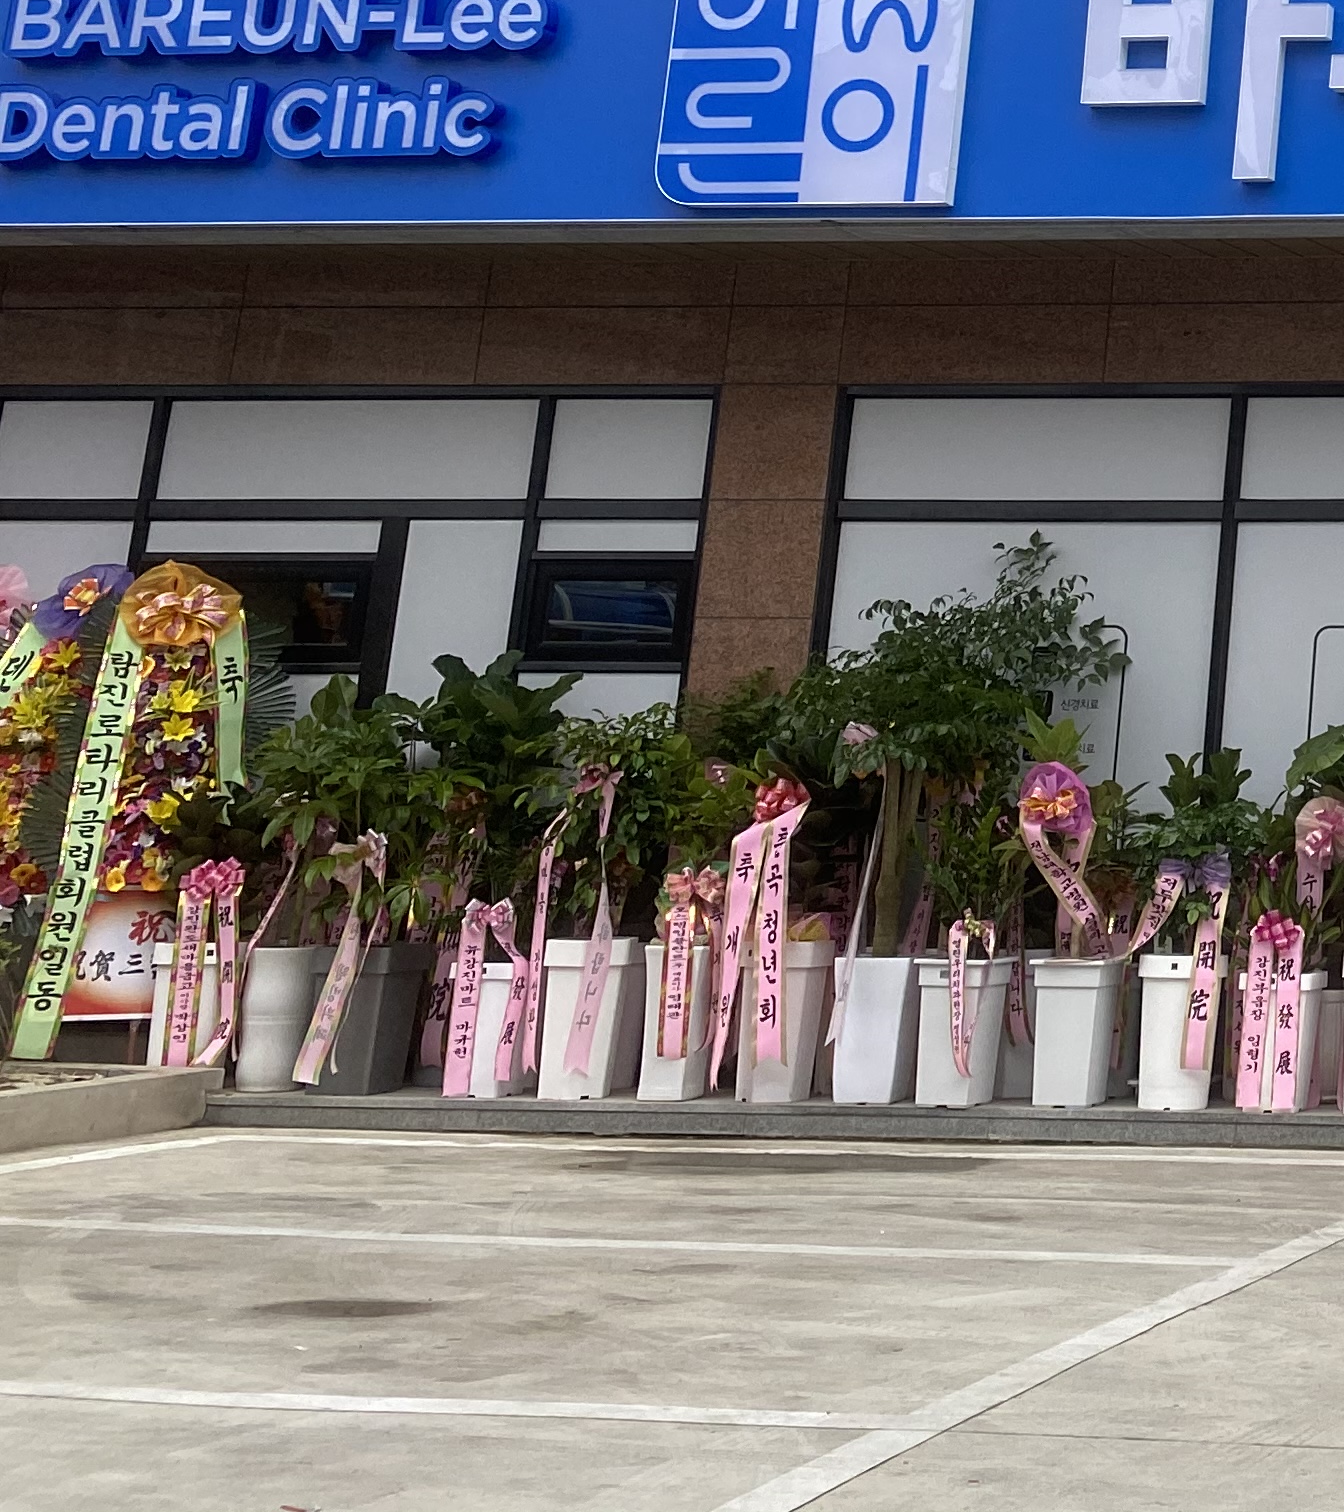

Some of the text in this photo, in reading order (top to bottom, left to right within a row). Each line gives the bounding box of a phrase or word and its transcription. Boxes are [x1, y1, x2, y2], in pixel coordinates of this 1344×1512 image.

[0, 76, 492, 160] Dental Clinic
[220, 656, 244, 704] 축
